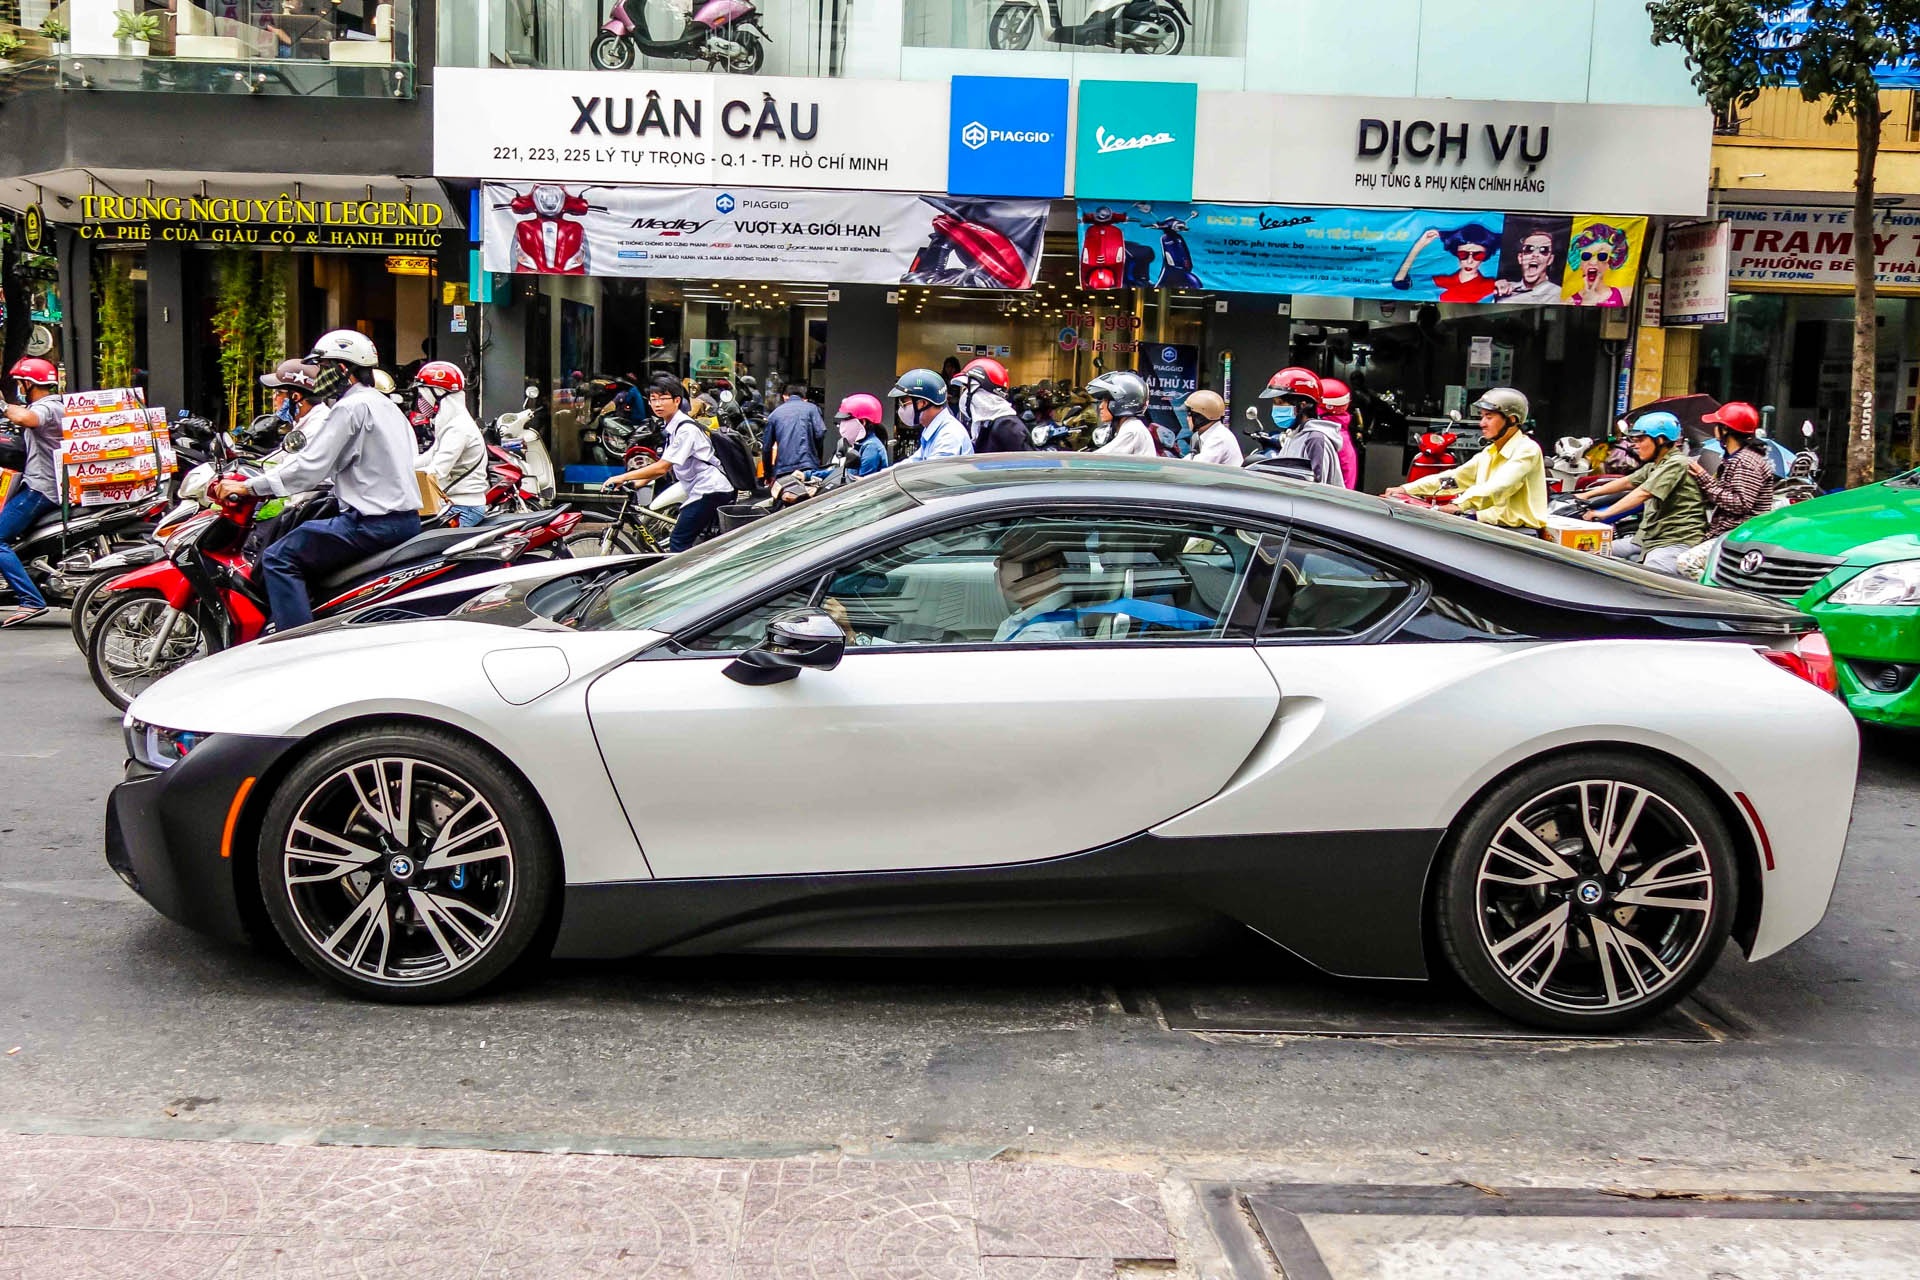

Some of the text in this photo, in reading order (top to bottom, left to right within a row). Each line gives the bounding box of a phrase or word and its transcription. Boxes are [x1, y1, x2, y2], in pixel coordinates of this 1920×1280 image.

[570, 90, 819, 141] XUÂN CẦU
[990, 131, 1050, 143] PIAGGIO
[1096, 125, 1176, 154] Vespa
[1358, 119, 1549, 172] DỊCH VỤ
[493, 147, 523, 163] 221,
[529, 148, 559, 163] 223,
[564, 149, 590, 162] 225
[596, 147, 615, 163] LÝ
[621, 150, 644, 167] TỰ
[649, 151, 705, 168] TRỌNG
[721, 153, 745, 167] Q.1
[762, 154, 784, 168] TP.
[790, 151, 812, 168] HỒ
[818, 153, 845, 170] CHÍ
[849, 157, 888, 172] MINH
[1355, 174, 1376, 190] PHỤ
[1414, 175, 1421, 188] &
[1425, 176, 1447, 192] PHỤ
[1450, 175, 1475, 192] KIỆN
[1479, 176, 1511, 191] CHÍNH
[79, 192, 443, 227] TRUNG NGUYÊN LEGEND
[743, 200, 789, 210] PIAGGIO
[630, 218, 716, 234] Medley
[1773, 210, 1808, 223] TÂM
[1812, 212, 1823, 223] Y
[1828, 211, 1851, 224] TẾ
[80, 221, 442, 250] CÀ PHÊ CỦA GIÀU CÓ & HẠNH PHÚC
[735, 219, 881, 239] VƯỢT XA GIỚI HẠN
[1731, 229, 1854, 256] TRẠM
[1741, 255, 1823, 271] PHƯỜNG
[1771, 271, 1815, 280] TRỌNG
[1153, 364, 1185, 373] PIAGGIO
[1182, 379, 1196, 390] XE
